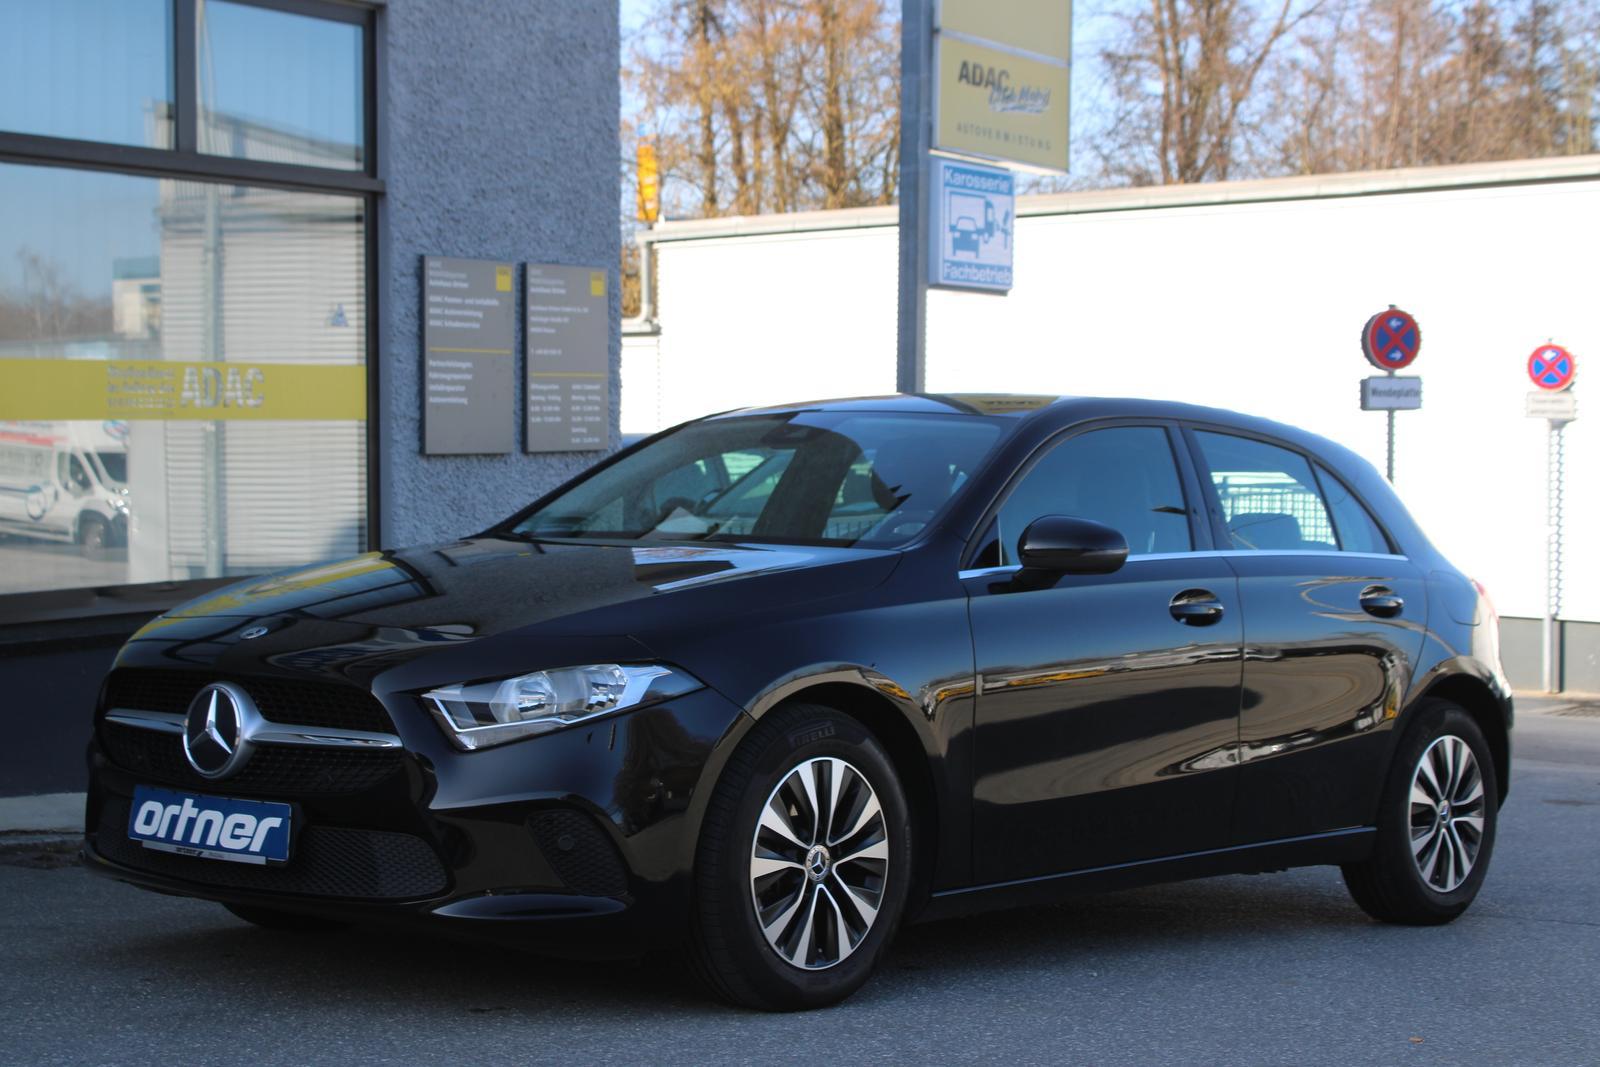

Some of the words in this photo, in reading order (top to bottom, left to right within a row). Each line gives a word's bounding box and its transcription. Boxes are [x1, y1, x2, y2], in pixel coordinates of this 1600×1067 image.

[958, 60, 1011, 92] ADAC
[944, 167, 1010, 194] Karosserie
[943, 262, 1012, 285] Fachbetrieb
[180, 367, 266, 409] ADAC
[786, 720, 835, 750] PIRELLI
[134, 798, 283, 852] ortner
